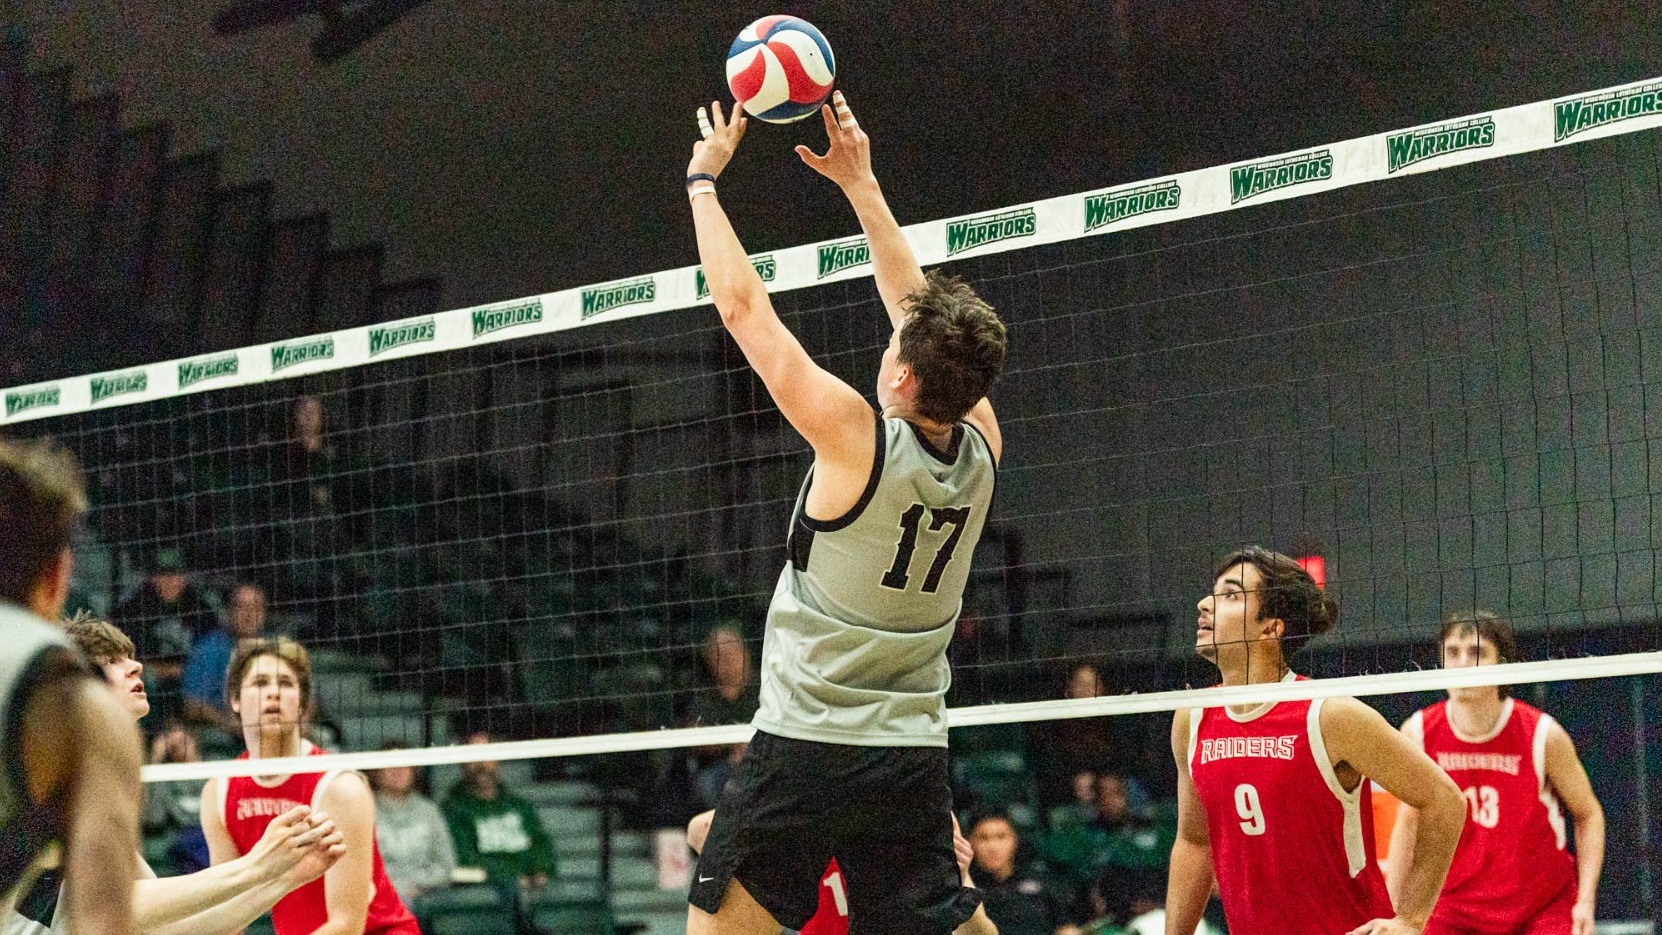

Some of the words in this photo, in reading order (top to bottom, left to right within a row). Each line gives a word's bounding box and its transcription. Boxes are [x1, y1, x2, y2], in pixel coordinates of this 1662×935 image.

[1387, 122, 1495, 174] WARRIORS
[1230, 155, 1333, 205] WARRIORS
[1084, 185, 1181, 233] WARRIORS
[946, 213, 1036, 258] WARRIORS
[472, 302, 543, 339] WARRIORS
[581, 282, 656, 320] WARRIORS
[271, 340, 334, 373] WARRIORS
[368, 320, 436, 357] WARRIORS
[880, 502, 973, 595] 17
[1201, 735, 1298, 765] RAIDERS
[1234, 783, 1266, 836] 9
[1463, 786, 1500, 829] 13
